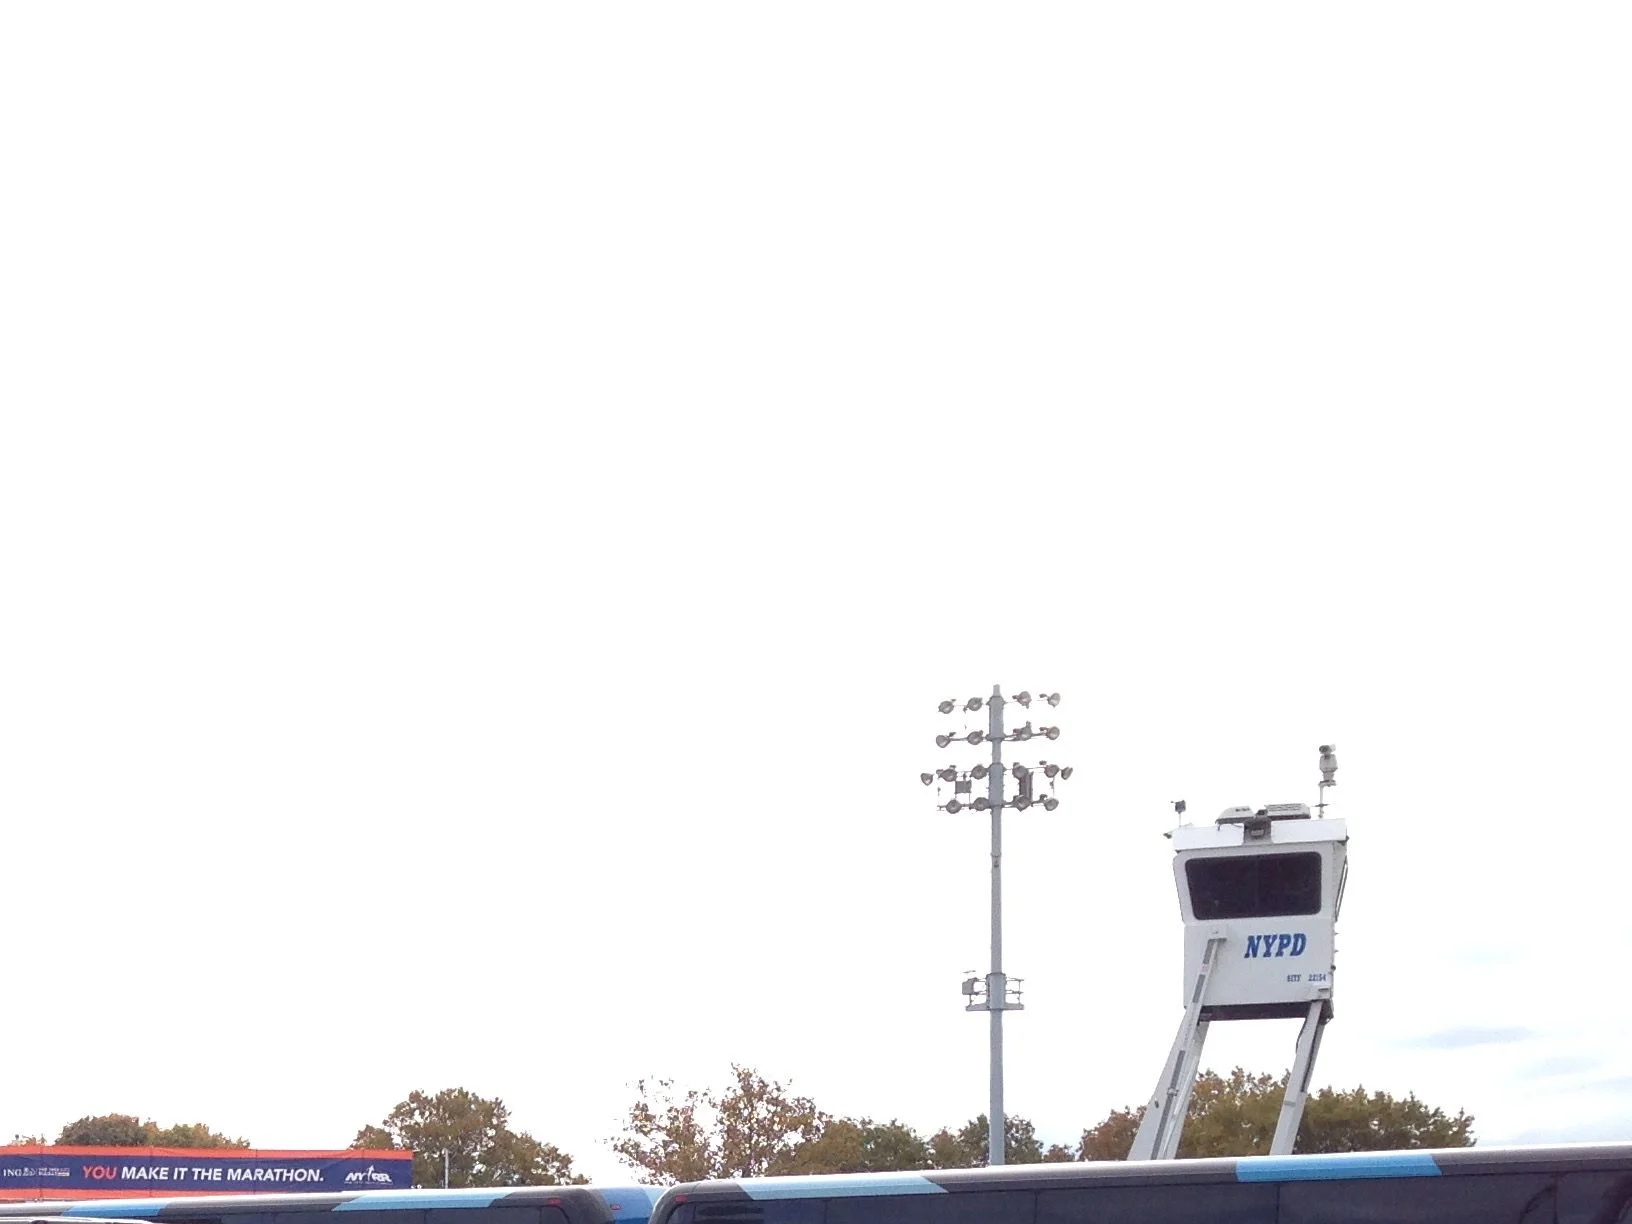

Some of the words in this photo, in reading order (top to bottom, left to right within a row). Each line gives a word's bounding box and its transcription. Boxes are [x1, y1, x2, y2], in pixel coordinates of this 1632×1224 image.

[1244, 932, 1307, 958] NYPD
[82, 1166, 117, 1180] YOU
[121, 1166, 169, 1180] MAKE
[173, 1168, 188, 1180] IT
[192, 1168, 222, 1180] THE
[227, 1169, 324, 1182] MARATHON.
